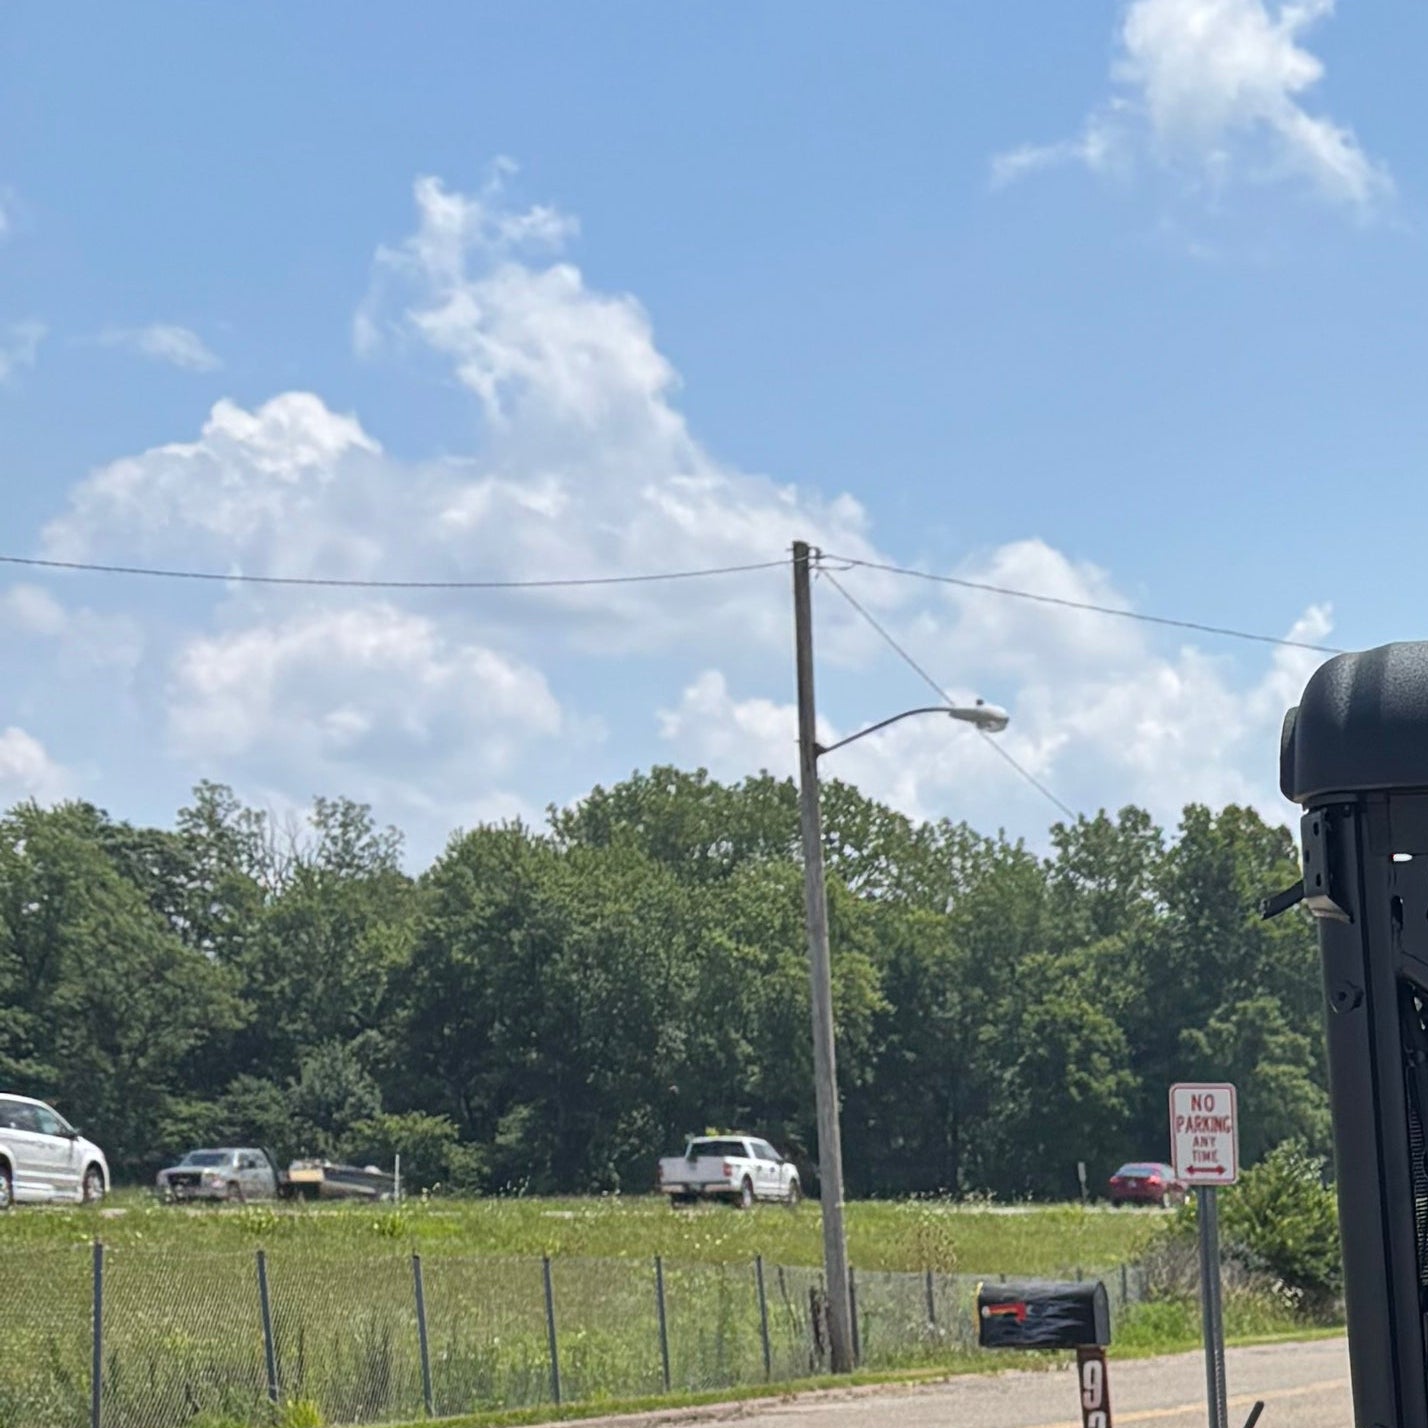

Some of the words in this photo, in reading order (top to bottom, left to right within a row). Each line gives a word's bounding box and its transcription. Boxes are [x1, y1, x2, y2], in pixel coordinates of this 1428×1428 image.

[1191, 1093, 1215, 1113] NO
[1175, 1115, 1231, 1134] PARKING
[1192, 1136, 1216, 1148] ANY
[1192, 1149, 1217, 1162] TIME
